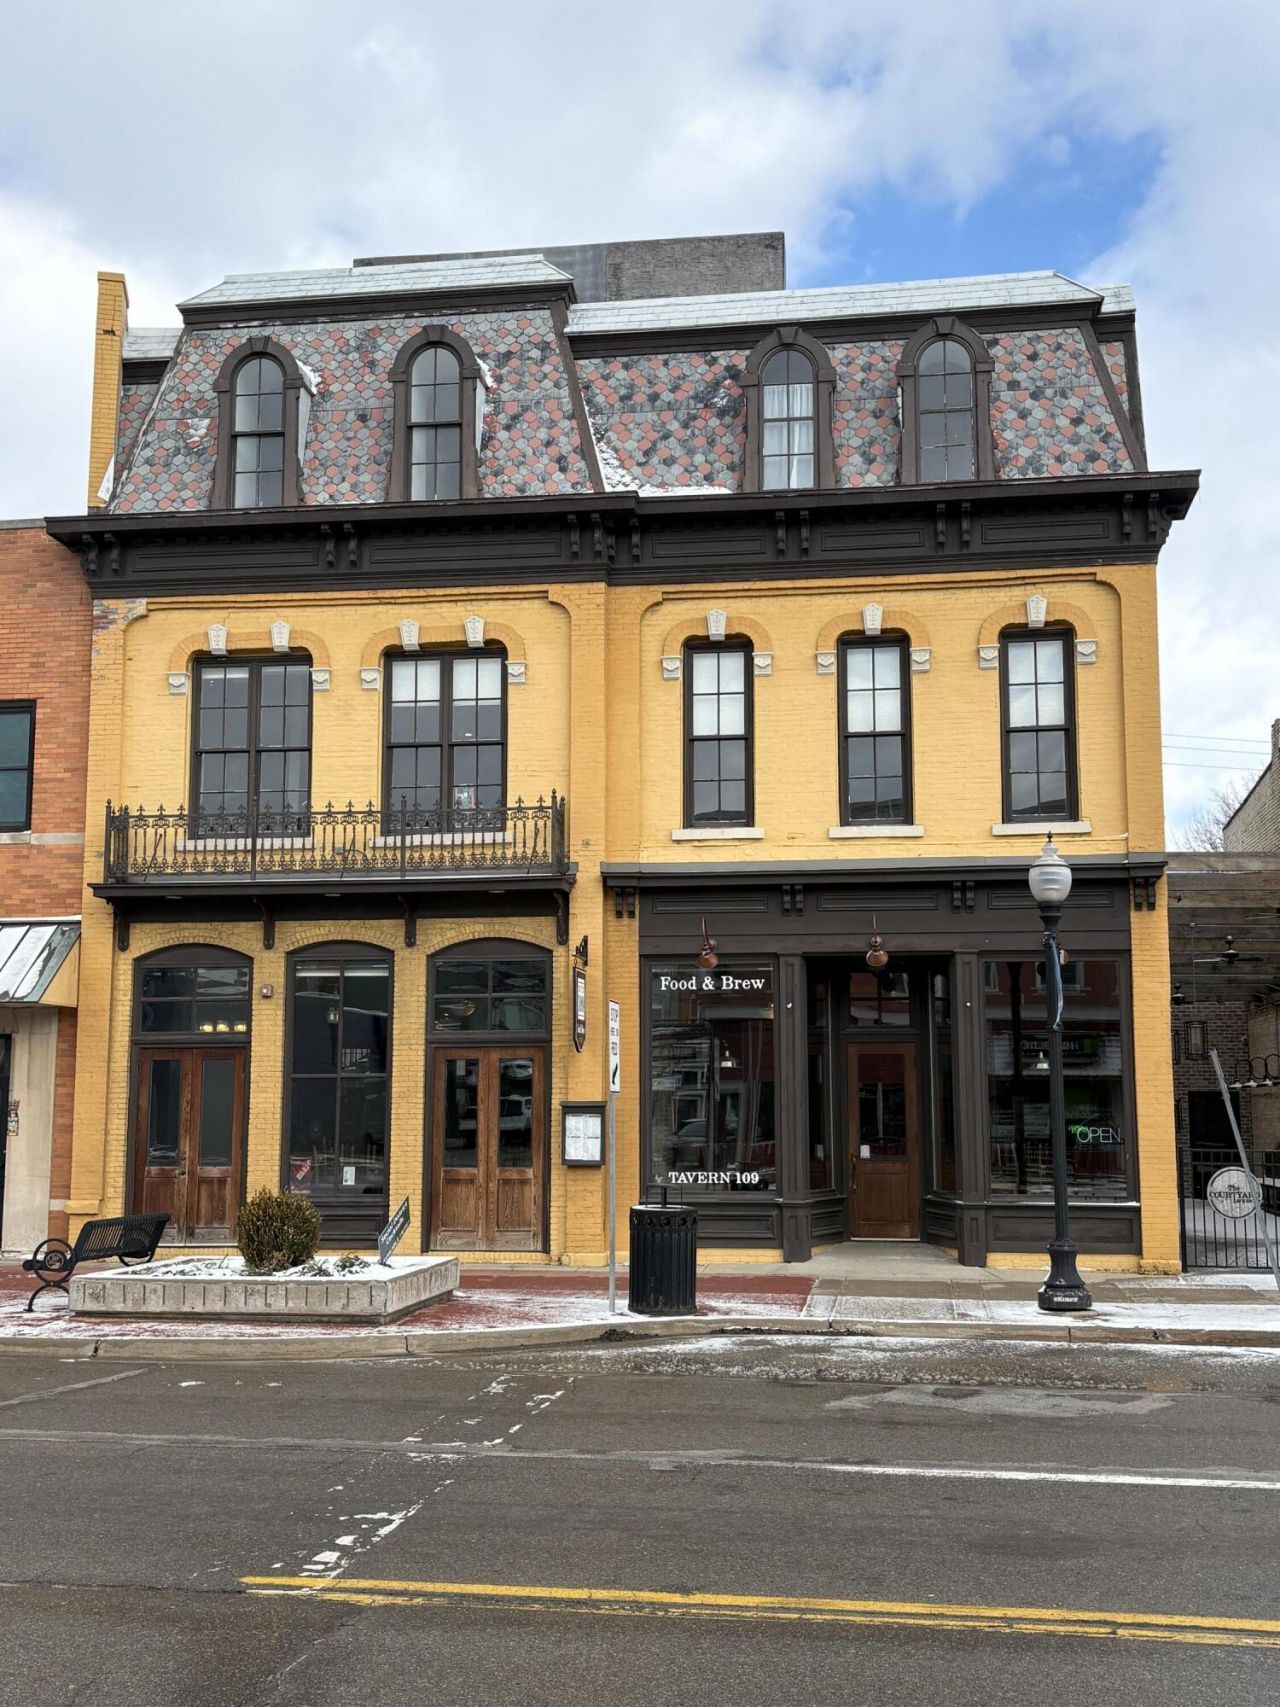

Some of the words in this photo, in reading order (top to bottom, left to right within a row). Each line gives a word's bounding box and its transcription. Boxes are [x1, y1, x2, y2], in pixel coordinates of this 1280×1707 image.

[660, 976, 697, 990] Food
[702, 976, 715, 990] &
[721, 976, 765, 990] Brew
[1077, 1127, 1120, 1143] OPEN
[668, 1171, 730, 1184] TAVERN
[735, 1171, 759, 1184] 109
